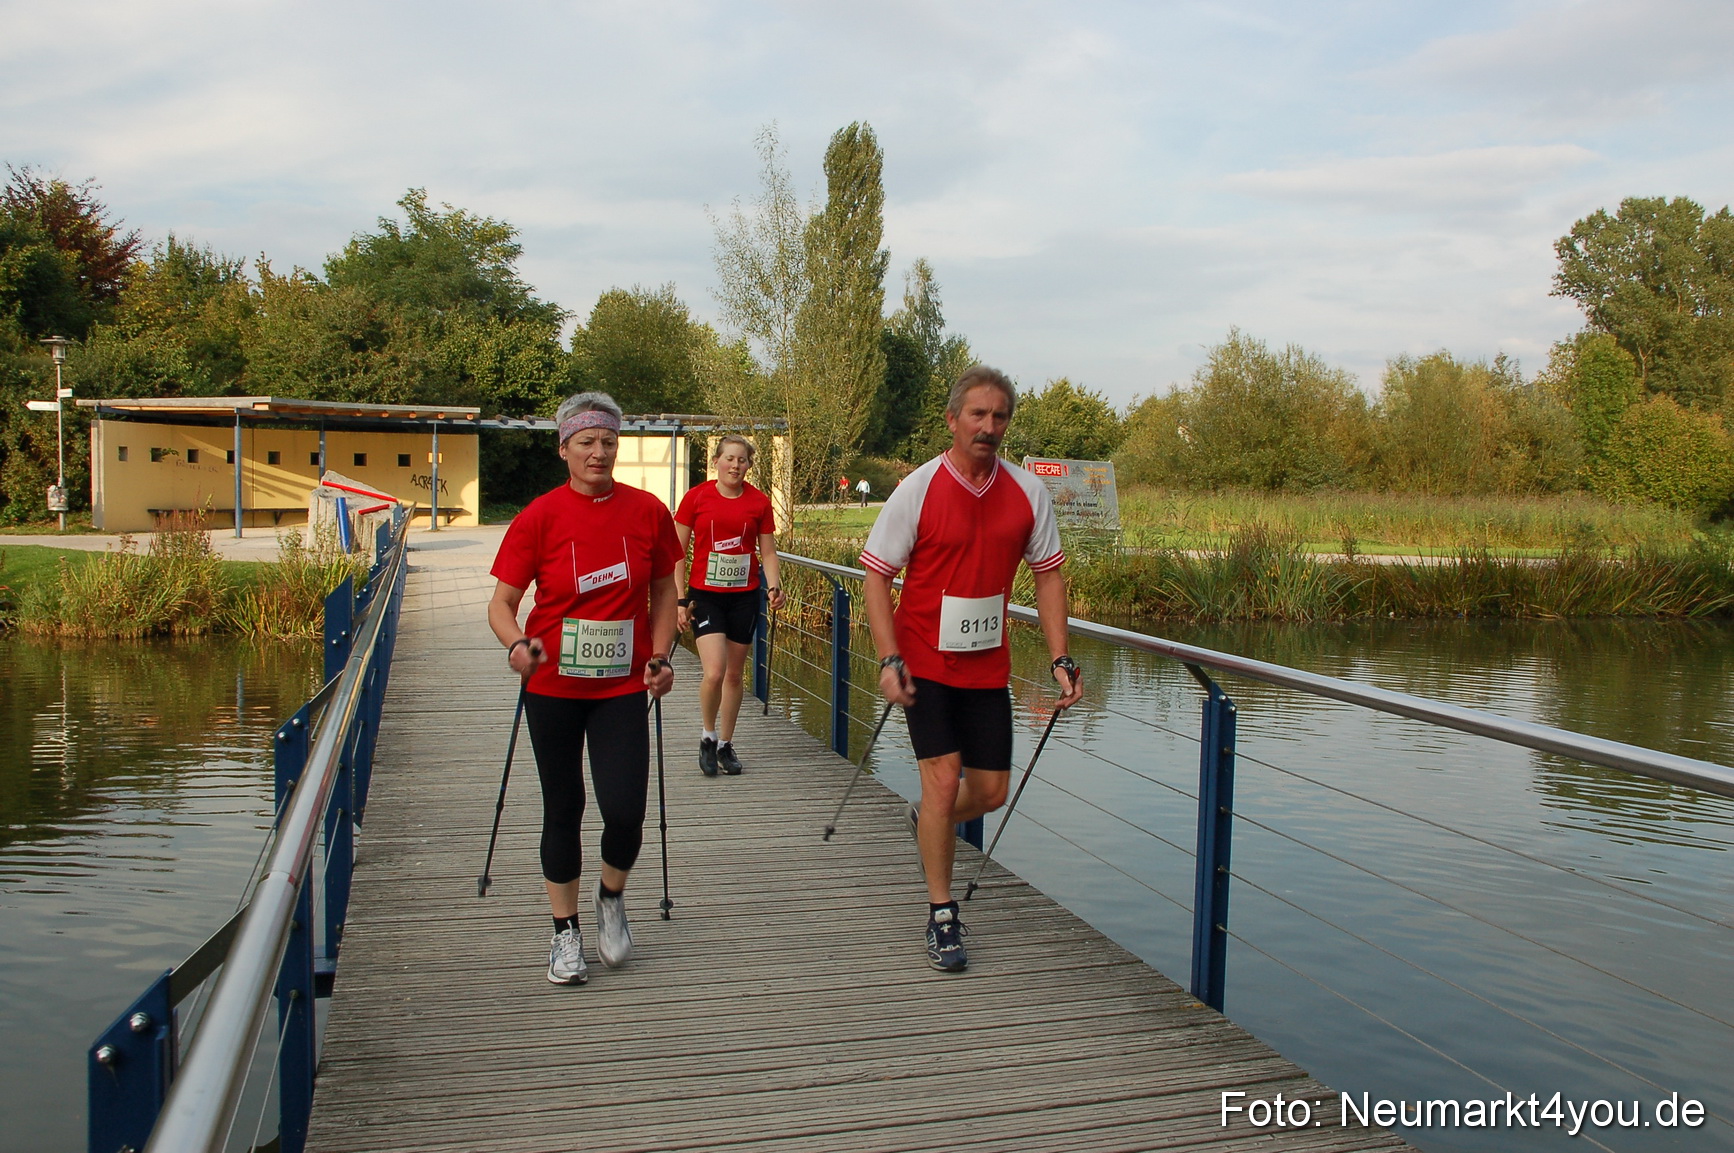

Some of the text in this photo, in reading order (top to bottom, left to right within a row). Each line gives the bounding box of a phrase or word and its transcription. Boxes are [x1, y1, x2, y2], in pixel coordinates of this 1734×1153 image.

[592, 571, 614, 585] DEHN
[719, 567, 746, 576] 8088
[581, 624, 624, 636] Marianne
[960, 616, 998, 634] 8113
[581, 642, 627, 658] 8083
